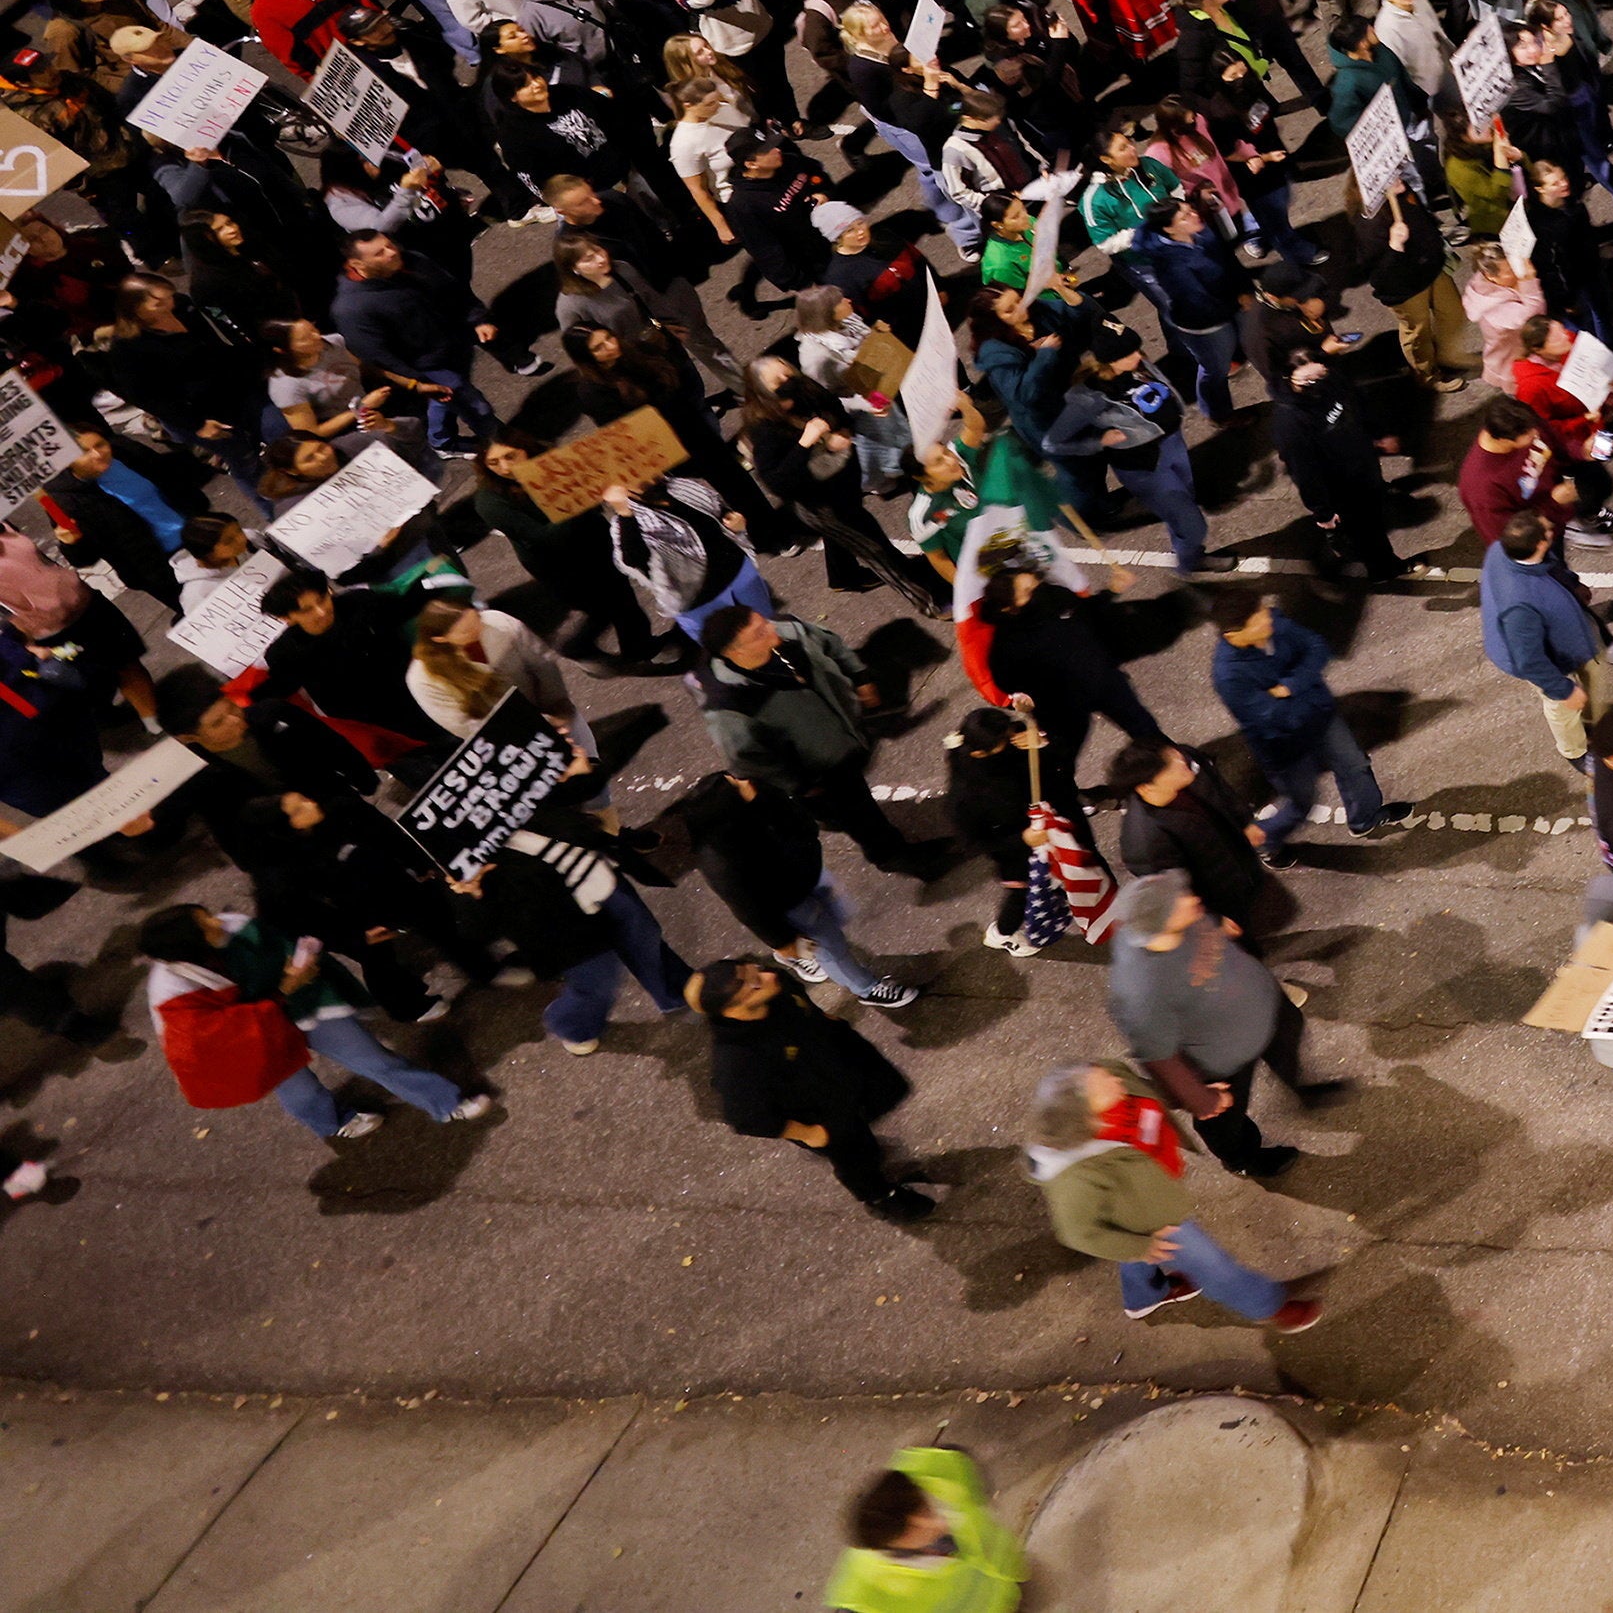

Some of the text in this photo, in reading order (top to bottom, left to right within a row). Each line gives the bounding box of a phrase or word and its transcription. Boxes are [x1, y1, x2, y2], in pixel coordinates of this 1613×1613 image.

[140, 46, 218, 126] DEMOCRACY
[197, 79, 259, 140] DISSENT
[335, 78, 393, 142] IMMIGRANTS
[0, 456, 58, 508] STRIKE!
[38, 437, 62, 460] &
[275, 453, 380, 541] NO HUMAN
[173, 558, 272, 652] FAMILIES
[412, 736, 496, 831] JESUS
